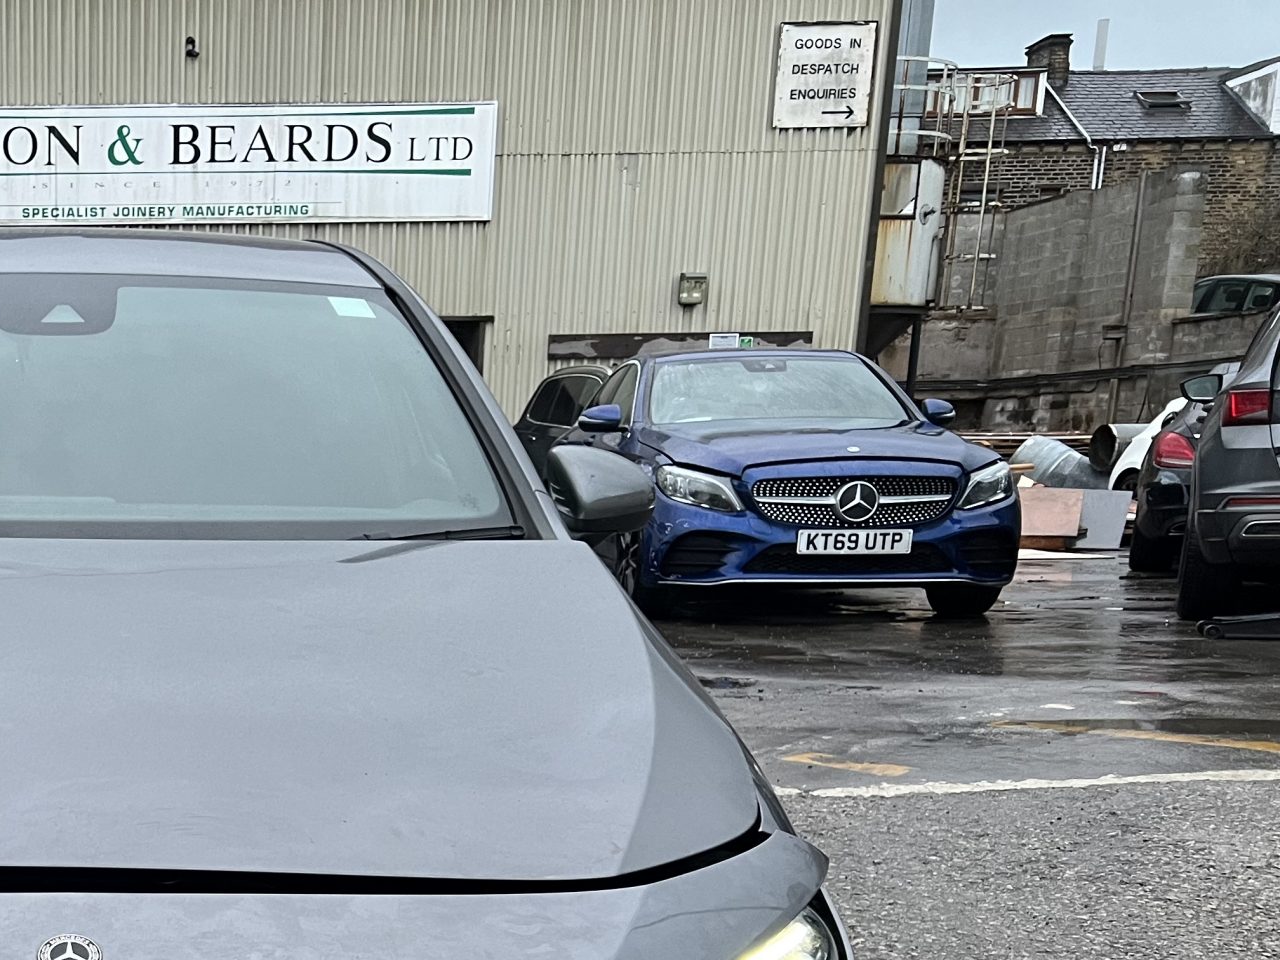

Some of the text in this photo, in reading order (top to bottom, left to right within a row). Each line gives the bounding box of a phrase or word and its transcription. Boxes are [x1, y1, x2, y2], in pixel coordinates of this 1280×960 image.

[794, 38, 862, 49] GOODS IN
[792, 63, 859, 74] DESPATCH
[789, 88, 856, 100] ENQUIRIES
[107, 124, 144, 166] &
[169, 121, 393, 165] BEARDS
[407, 136, 473, 162] LTD
[22, 204, 309, 218] SPECIALIST JOINERY MANUFACTURING
[806, 532, 903, 551] KT69 UTP
